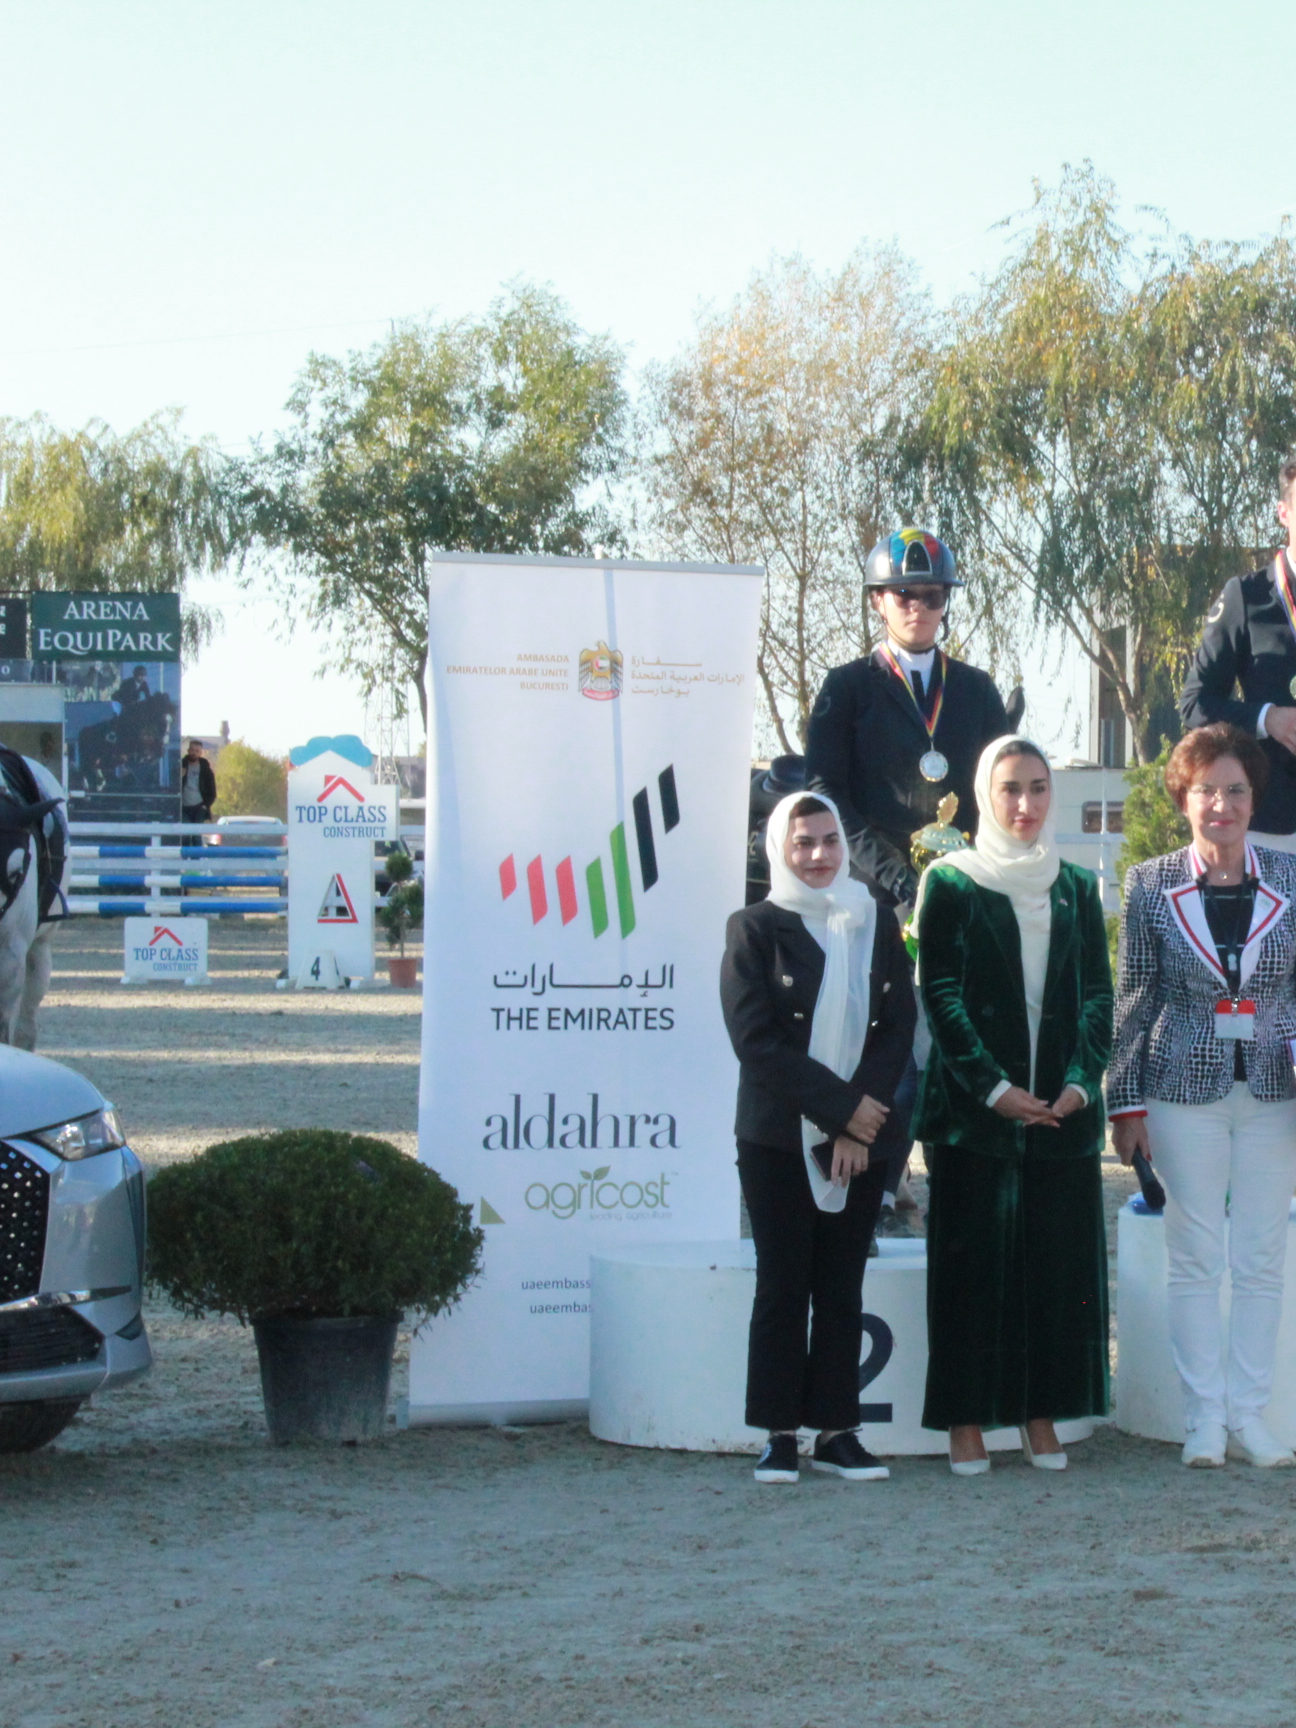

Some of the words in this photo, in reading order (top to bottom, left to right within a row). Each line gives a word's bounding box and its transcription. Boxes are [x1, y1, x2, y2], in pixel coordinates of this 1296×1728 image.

[63, 600, 150, 621] ARENA
[516, 653, 570, 663] AMBASADA
[446, 665, 507, 676] EMIRATELOR
[508, 667, 539, 677] ARABE
[541, 668, 569, 678] UNITE
[520, 681, 569, 691] BUCURESTI
[295, 805, 328, 823] TOP
[333, 805, 387, 823] CLASS
[323, 826, 387, 838] CONSTRUCT
[133, 947, 157, 961] TOP
[160, 948, 199, 961] CLASS
[152, 962, 199, 972] CONSTRUCT
[311, 956, 320, 981] 4
[491, 1007, 539, 1031] THE
[547, 1007, 675, 1031] EMIRATES
[482, 1092, 682, 1150] aldahra
[525, 1169, 671, 1220] agricost
[521, 1277, 592, 1290] uaeembass
